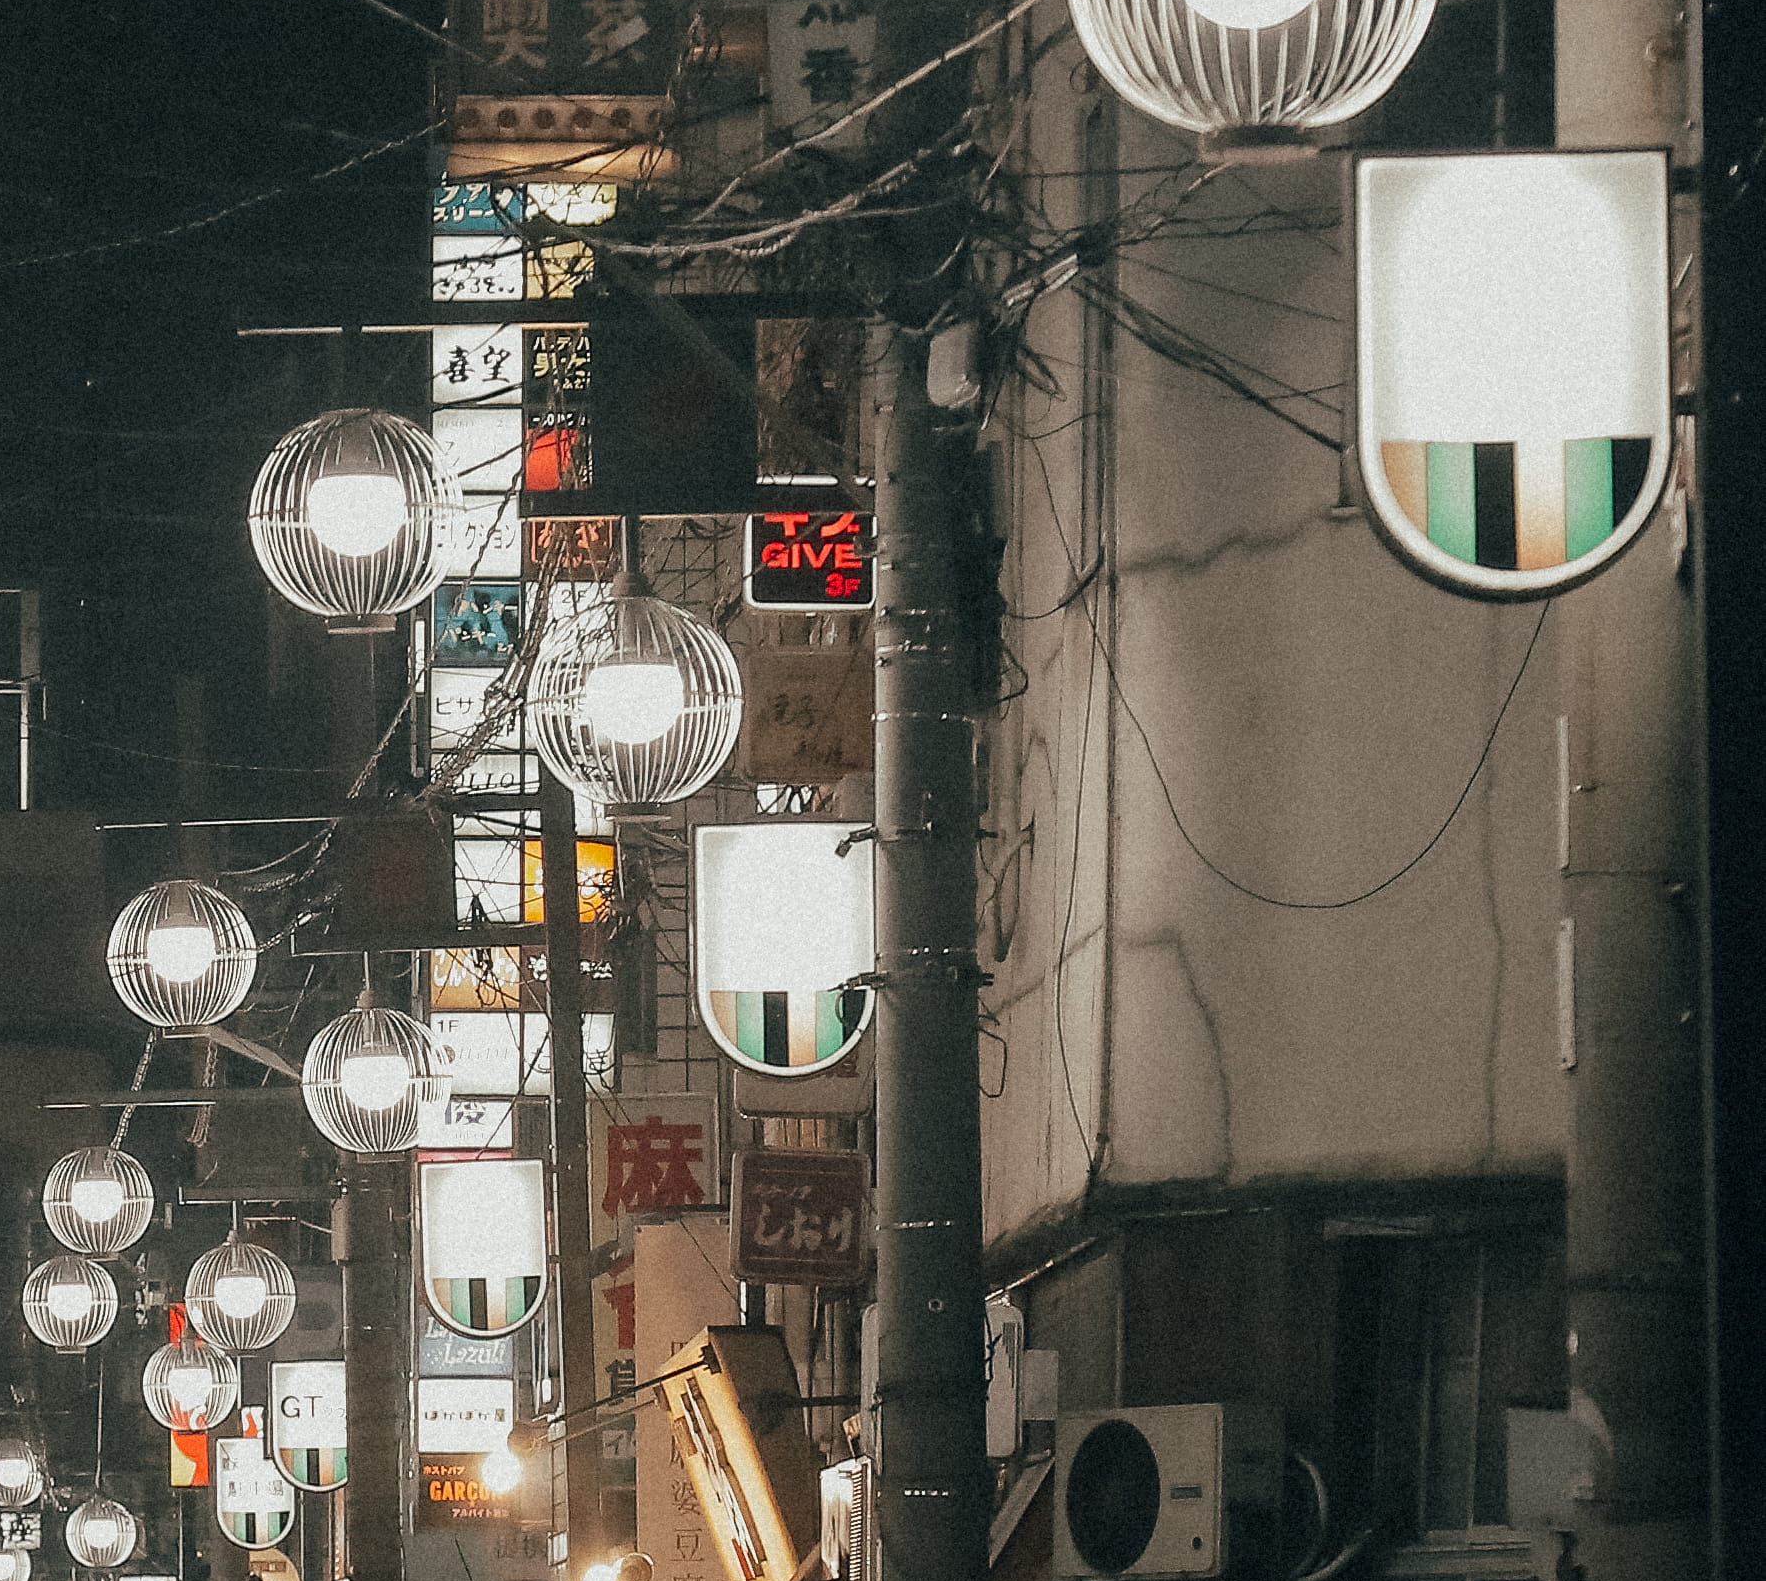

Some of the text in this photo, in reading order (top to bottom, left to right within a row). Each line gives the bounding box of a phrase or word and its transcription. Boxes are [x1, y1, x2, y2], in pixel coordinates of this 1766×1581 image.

[441, 345, 512, 384] 喜望
[760, 542, 863, 569] GIVE
[825, 572, 862, 598] 3F
[437, 1019, 460, 1034] 1F
[443, 1339, 509, 1365] Lazuli
[280, 1395, 324, 1419] GT
[428, 1479, 504, 1508] GARÇO
